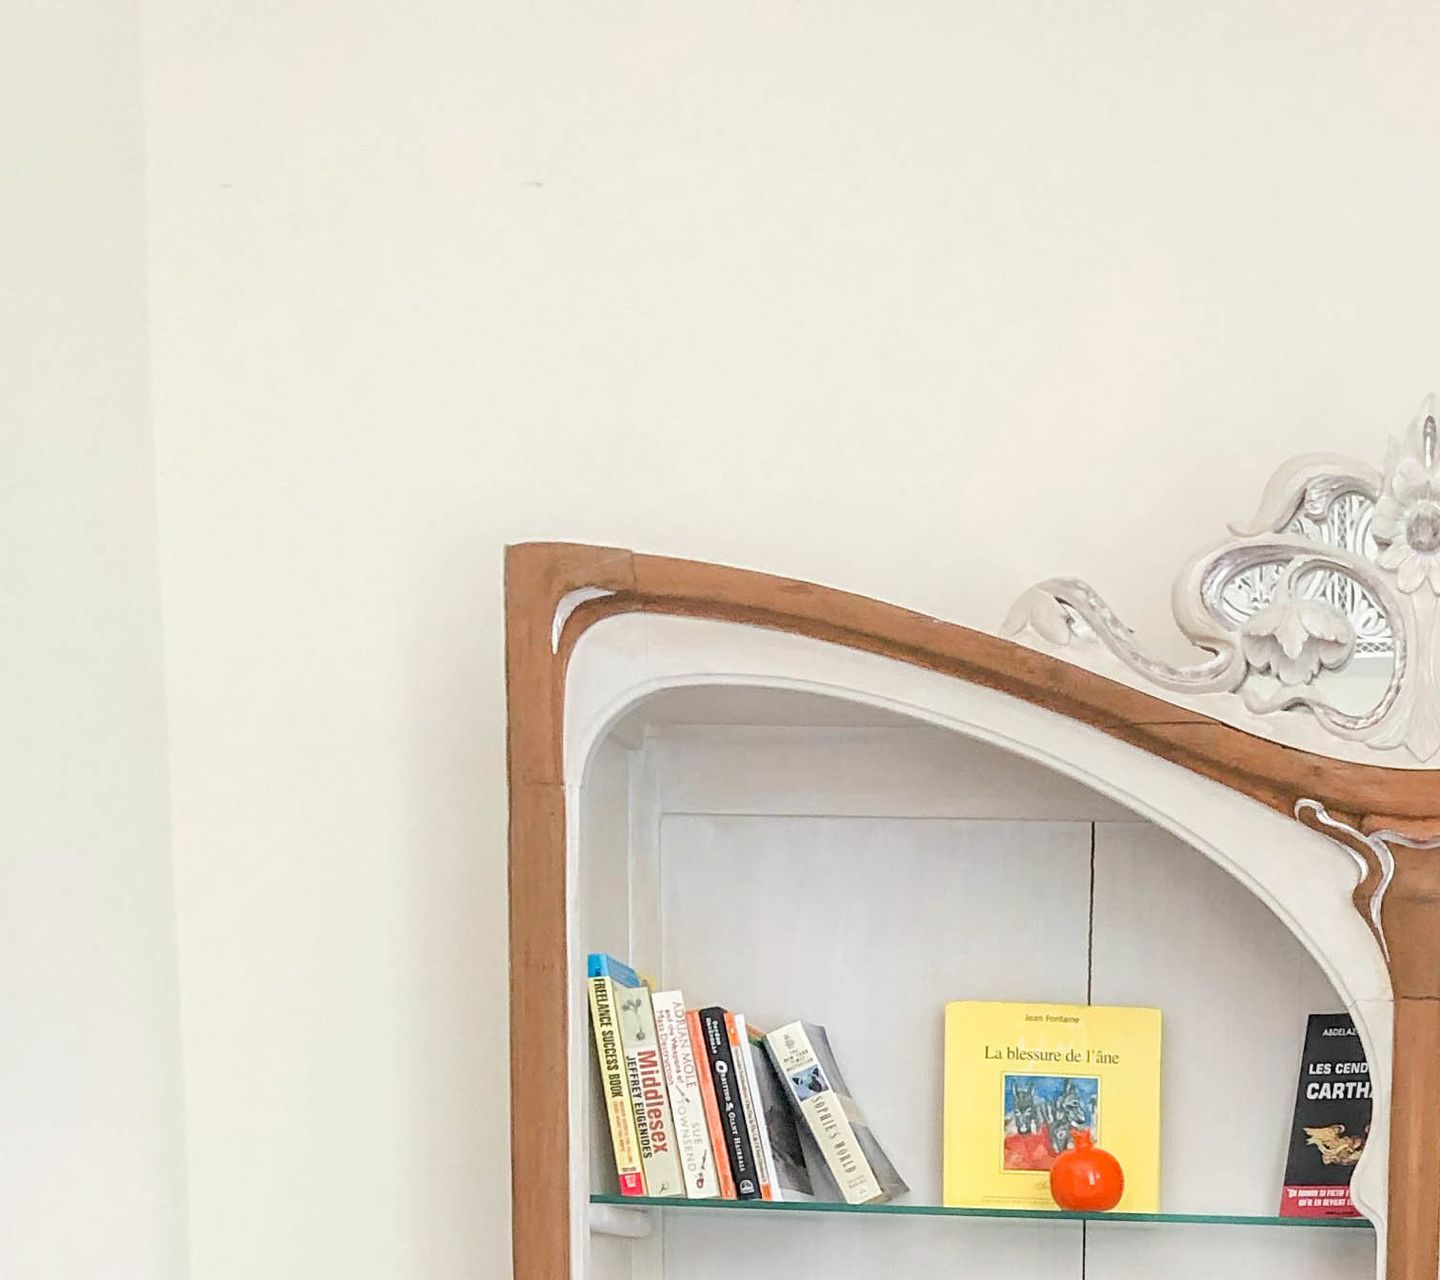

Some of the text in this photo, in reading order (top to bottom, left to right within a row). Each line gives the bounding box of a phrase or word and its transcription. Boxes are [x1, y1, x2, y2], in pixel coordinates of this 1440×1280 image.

[592, 977, 612, 1027] FREELANCE
[601, 1029, 618, 1070] SUCCESS
[672, 1000, 696, 1088] ADRIAN MOLE
[985, 1045, 1003, 1060] La
[1007, 1046, 1062, 1062] blessure
[1065, 1048, 1082, 1063] de
[608, 1073, 623, 1098] BOOK
[1309, 1063, 1331, 1075] LES
[625, 1054, 652, 1158] JEFFREY EUGENIDES
[636, 1048, 668, 1154] Middlesex
